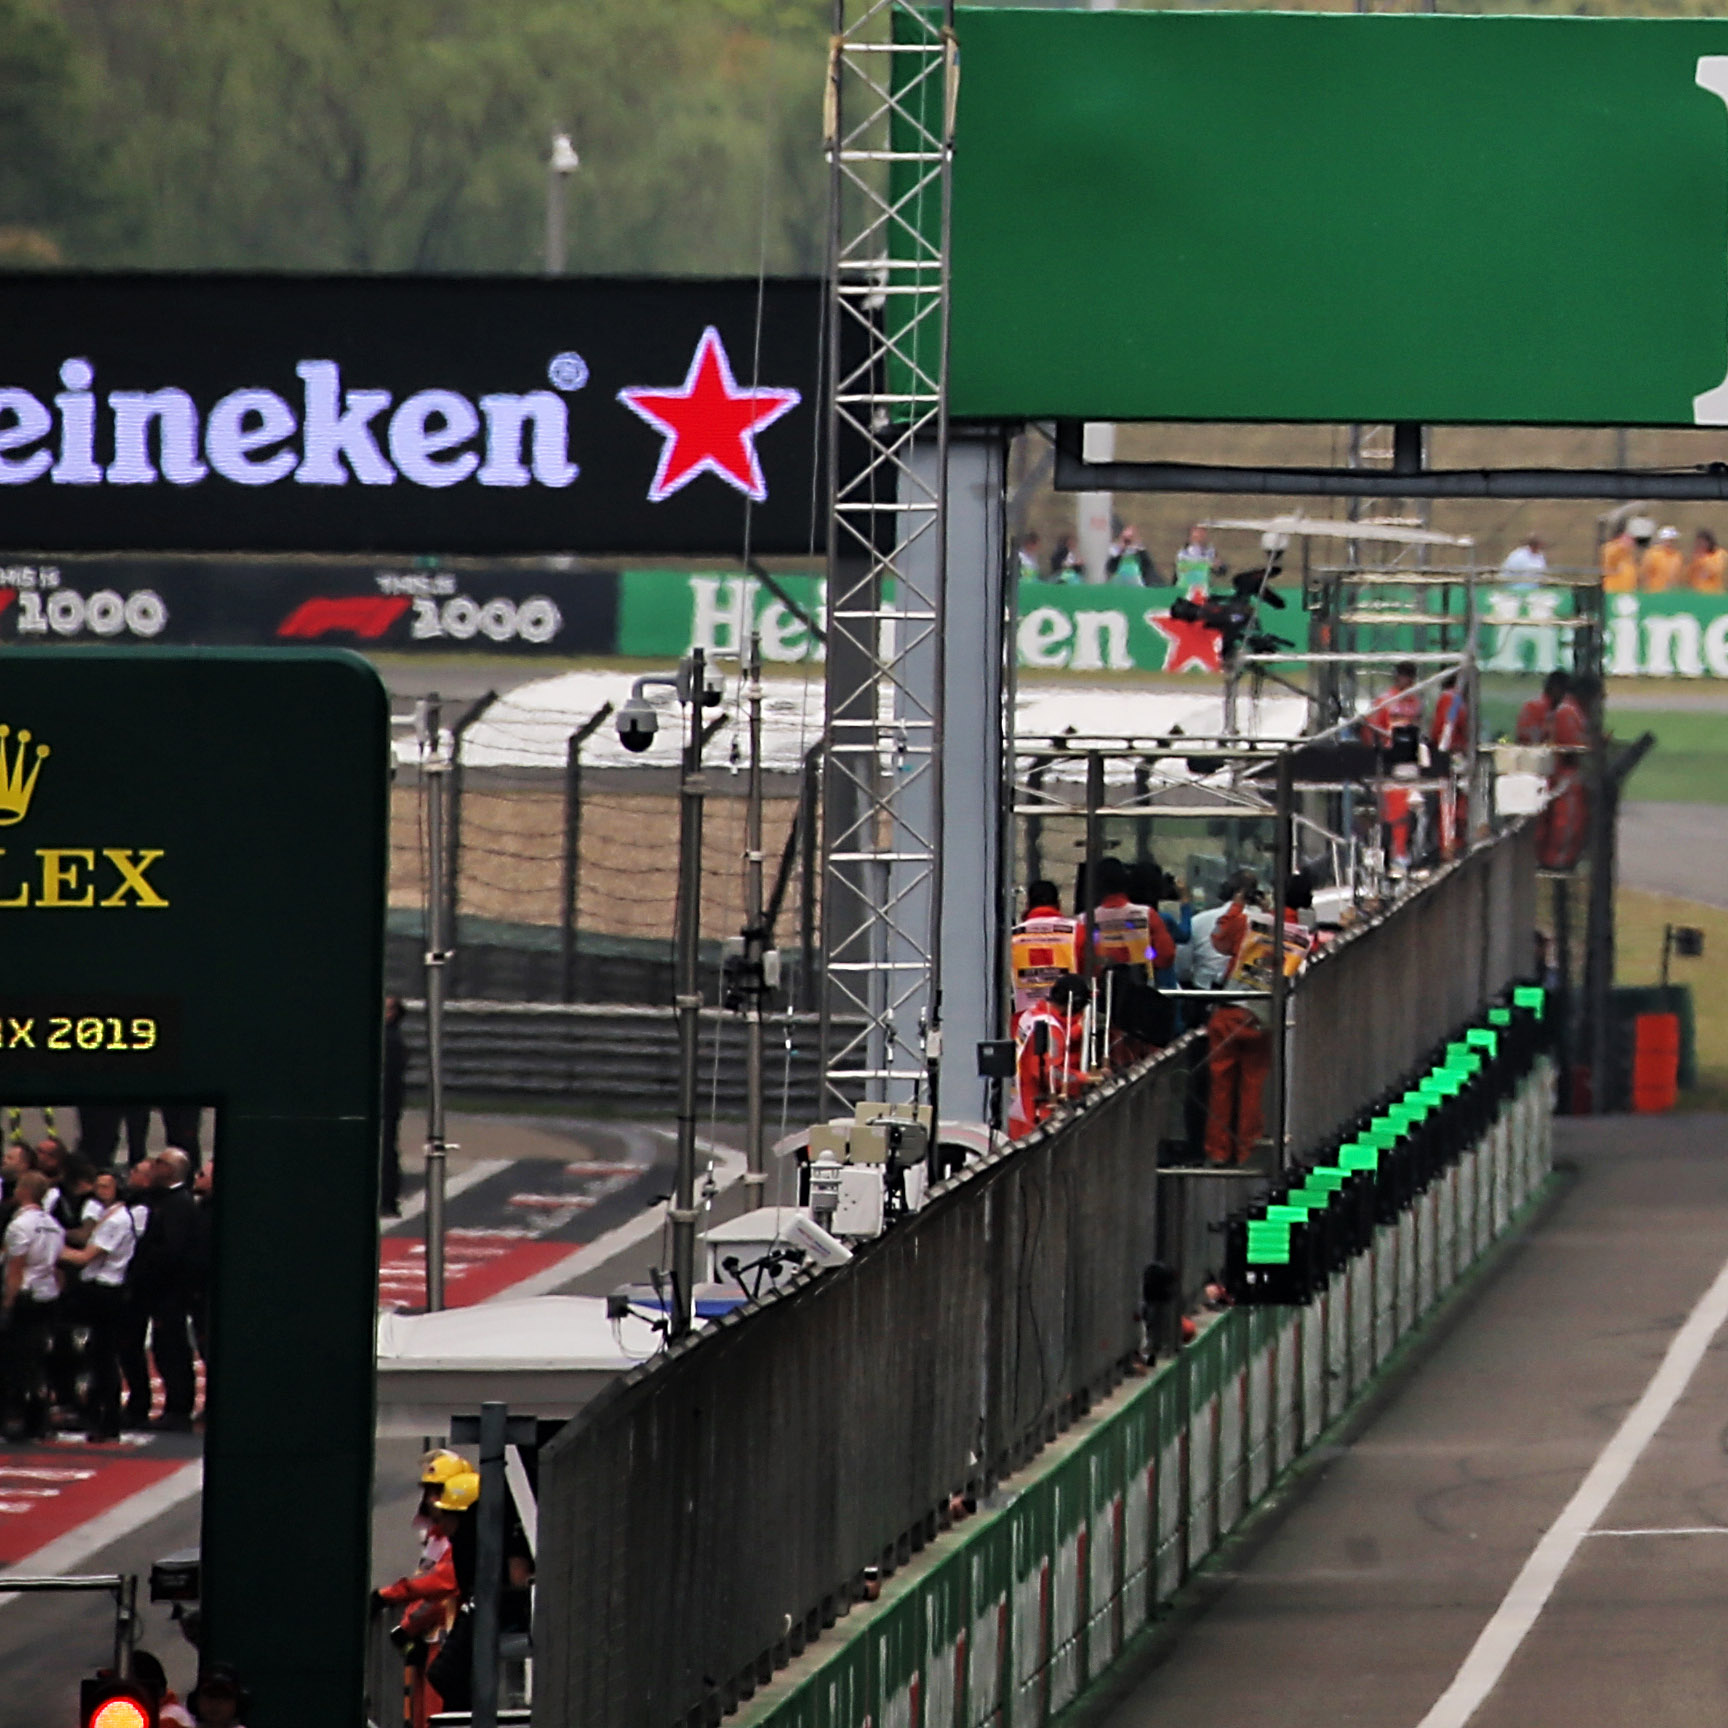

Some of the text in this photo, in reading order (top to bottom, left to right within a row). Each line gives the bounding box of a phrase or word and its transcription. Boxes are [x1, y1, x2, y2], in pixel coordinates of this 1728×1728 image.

[18, 589, 168, 638] 1000
[411, 593, 564, 643] 1000
[48, 1017, 156, 1050] 2019
